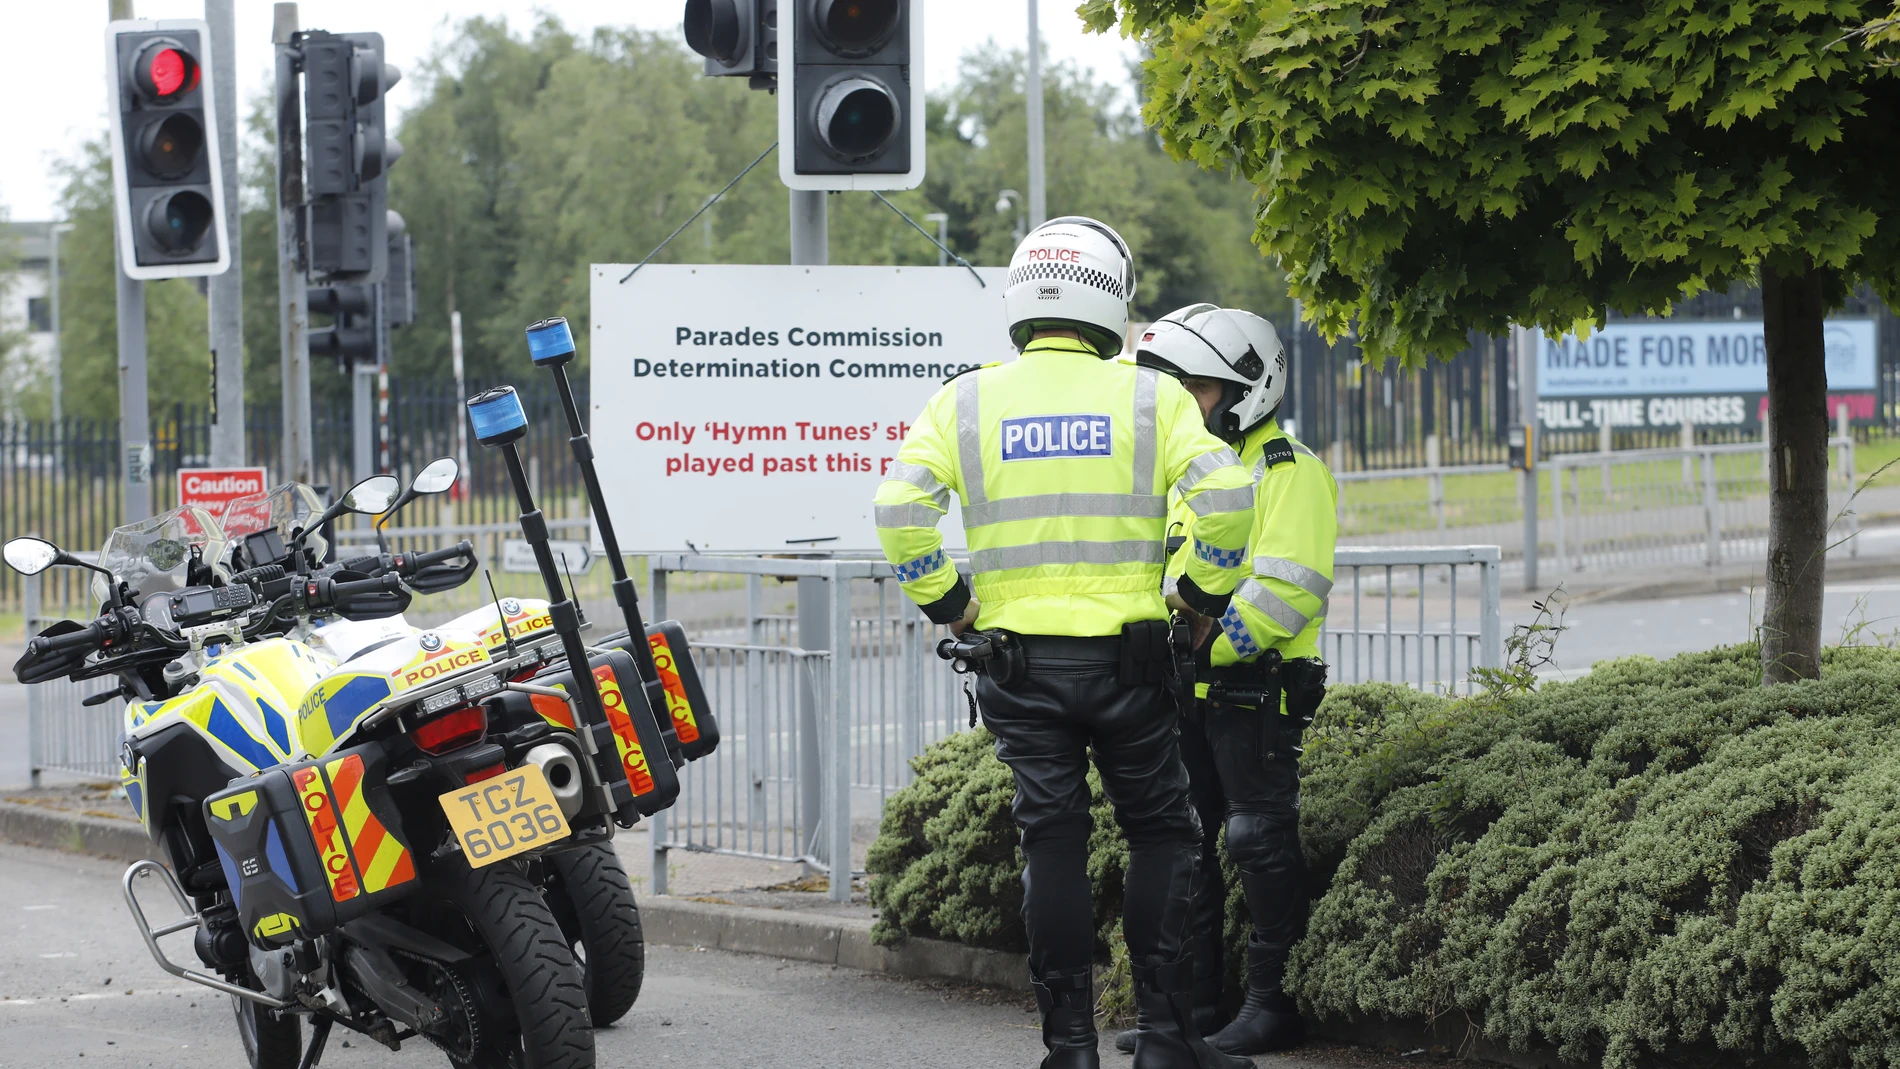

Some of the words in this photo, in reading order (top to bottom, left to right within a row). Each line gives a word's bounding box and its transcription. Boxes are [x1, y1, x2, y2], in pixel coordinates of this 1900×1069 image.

[1028, 248, 1080, 264] POLICE
[1039, 287, 1059, 295] SHOEI
[676, 327, 779, 347] Parades
[788, 327, 943, 347] Commission
[1546, 337, 1628, 368] MADE
[1641, 336, 1695, 366] FOR
[1708, 335, 1767, 365] MOR
[633, 358, 821, 378] Determination
[829, 358, 982, 378] Commence
[1647, 396, 1746, 425] COURSES
[635, 421, 696, 444] Only
[705, 422, 787, 444] ‘Hymn
[795, 422, 878, 441] Tunes’
[1005, 420, 1107, 454] POLICE
[666, 453, 754, 476] played
[763, 455, 818, 476] past
[826, 453, 872, 473] this
[1267, 451, 1292, 460] 23769
[185, 476, 259, 495] Caution
[186, 499, 226, 512] Heavy
[490, 615, 553, 645] POLICE
[405, 650, 483, 687] POLICE
[647, 636, 695, 741] POLICE
[298, 686, 327, 725] POLICE
[594, 671, 653, 793] POLICE
[458, 775, 536, 822] TGZ
[297, 770, 353, 897] POLICE
[463, 804, 562, 859] 6036
[242, 858, 259, 876] GS
